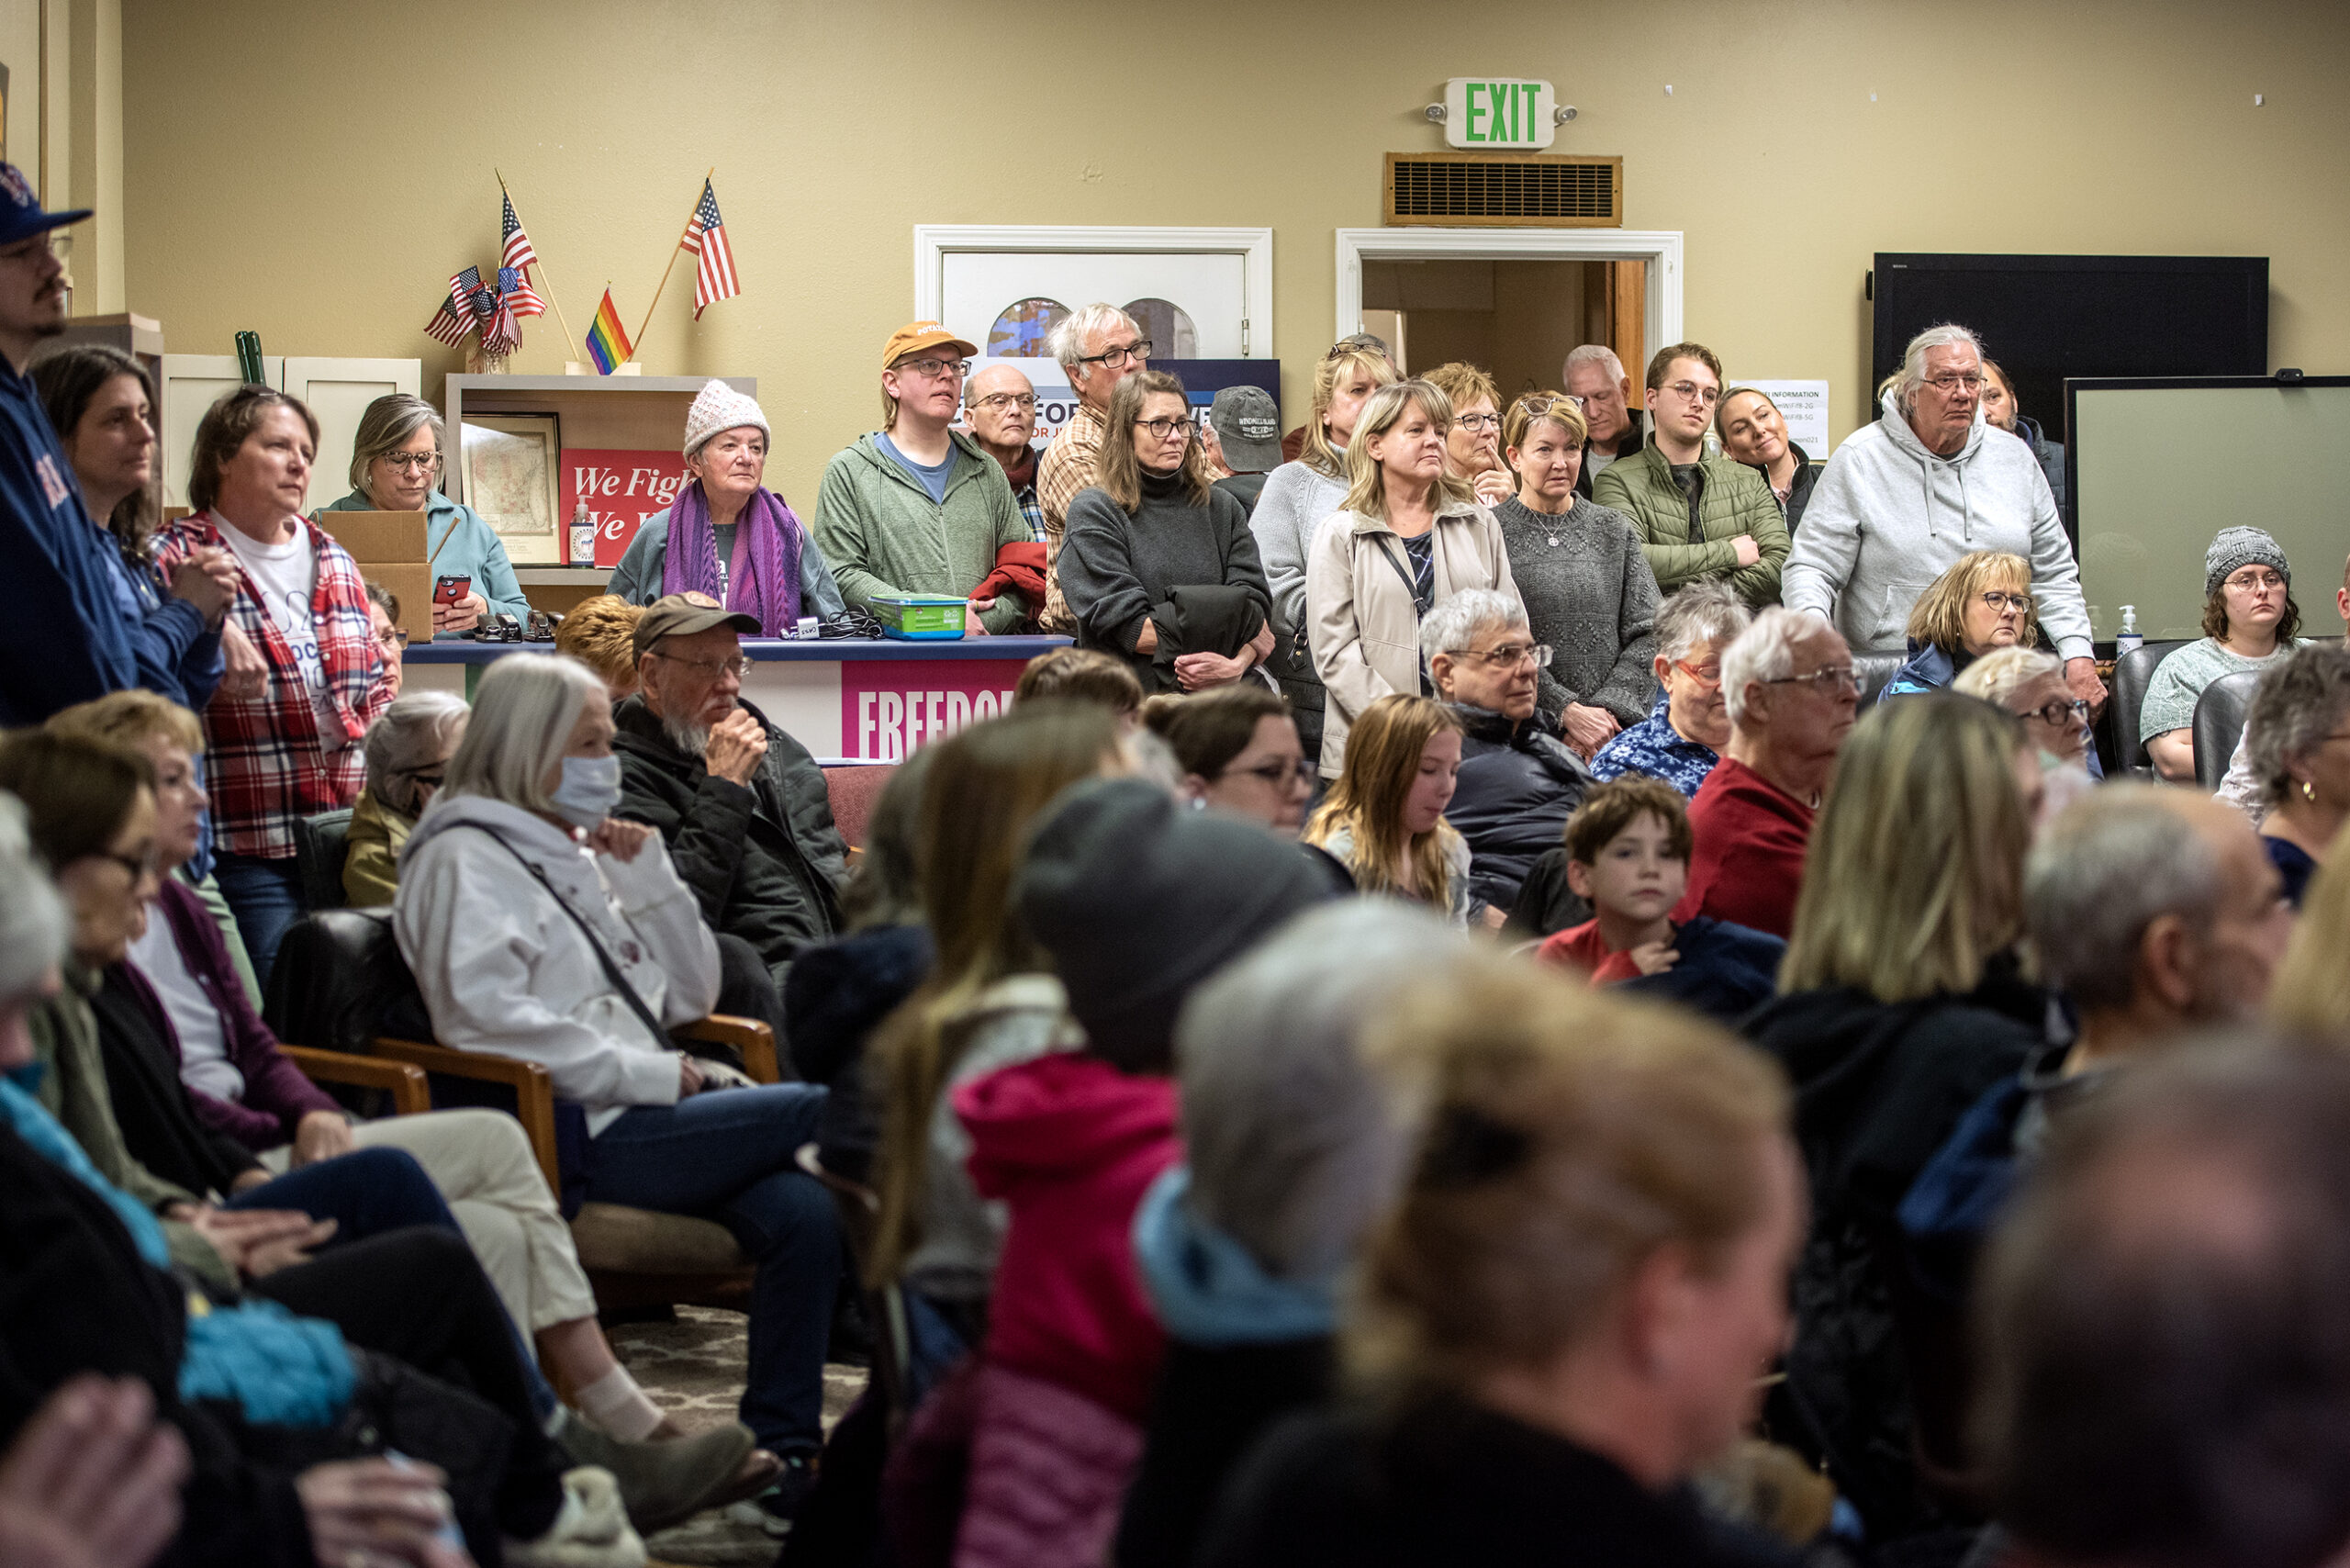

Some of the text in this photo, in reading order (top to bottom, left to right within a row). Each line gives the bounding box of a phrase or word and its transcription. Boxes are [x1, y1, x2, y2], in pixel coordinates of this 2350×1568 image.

[1466, 84, 1540, 142] EXIT
[1032, 427, 1049, 438] OR
[574, 466, 698, 505] We Figh
[858, 689, 1014, 761] FREEDO
